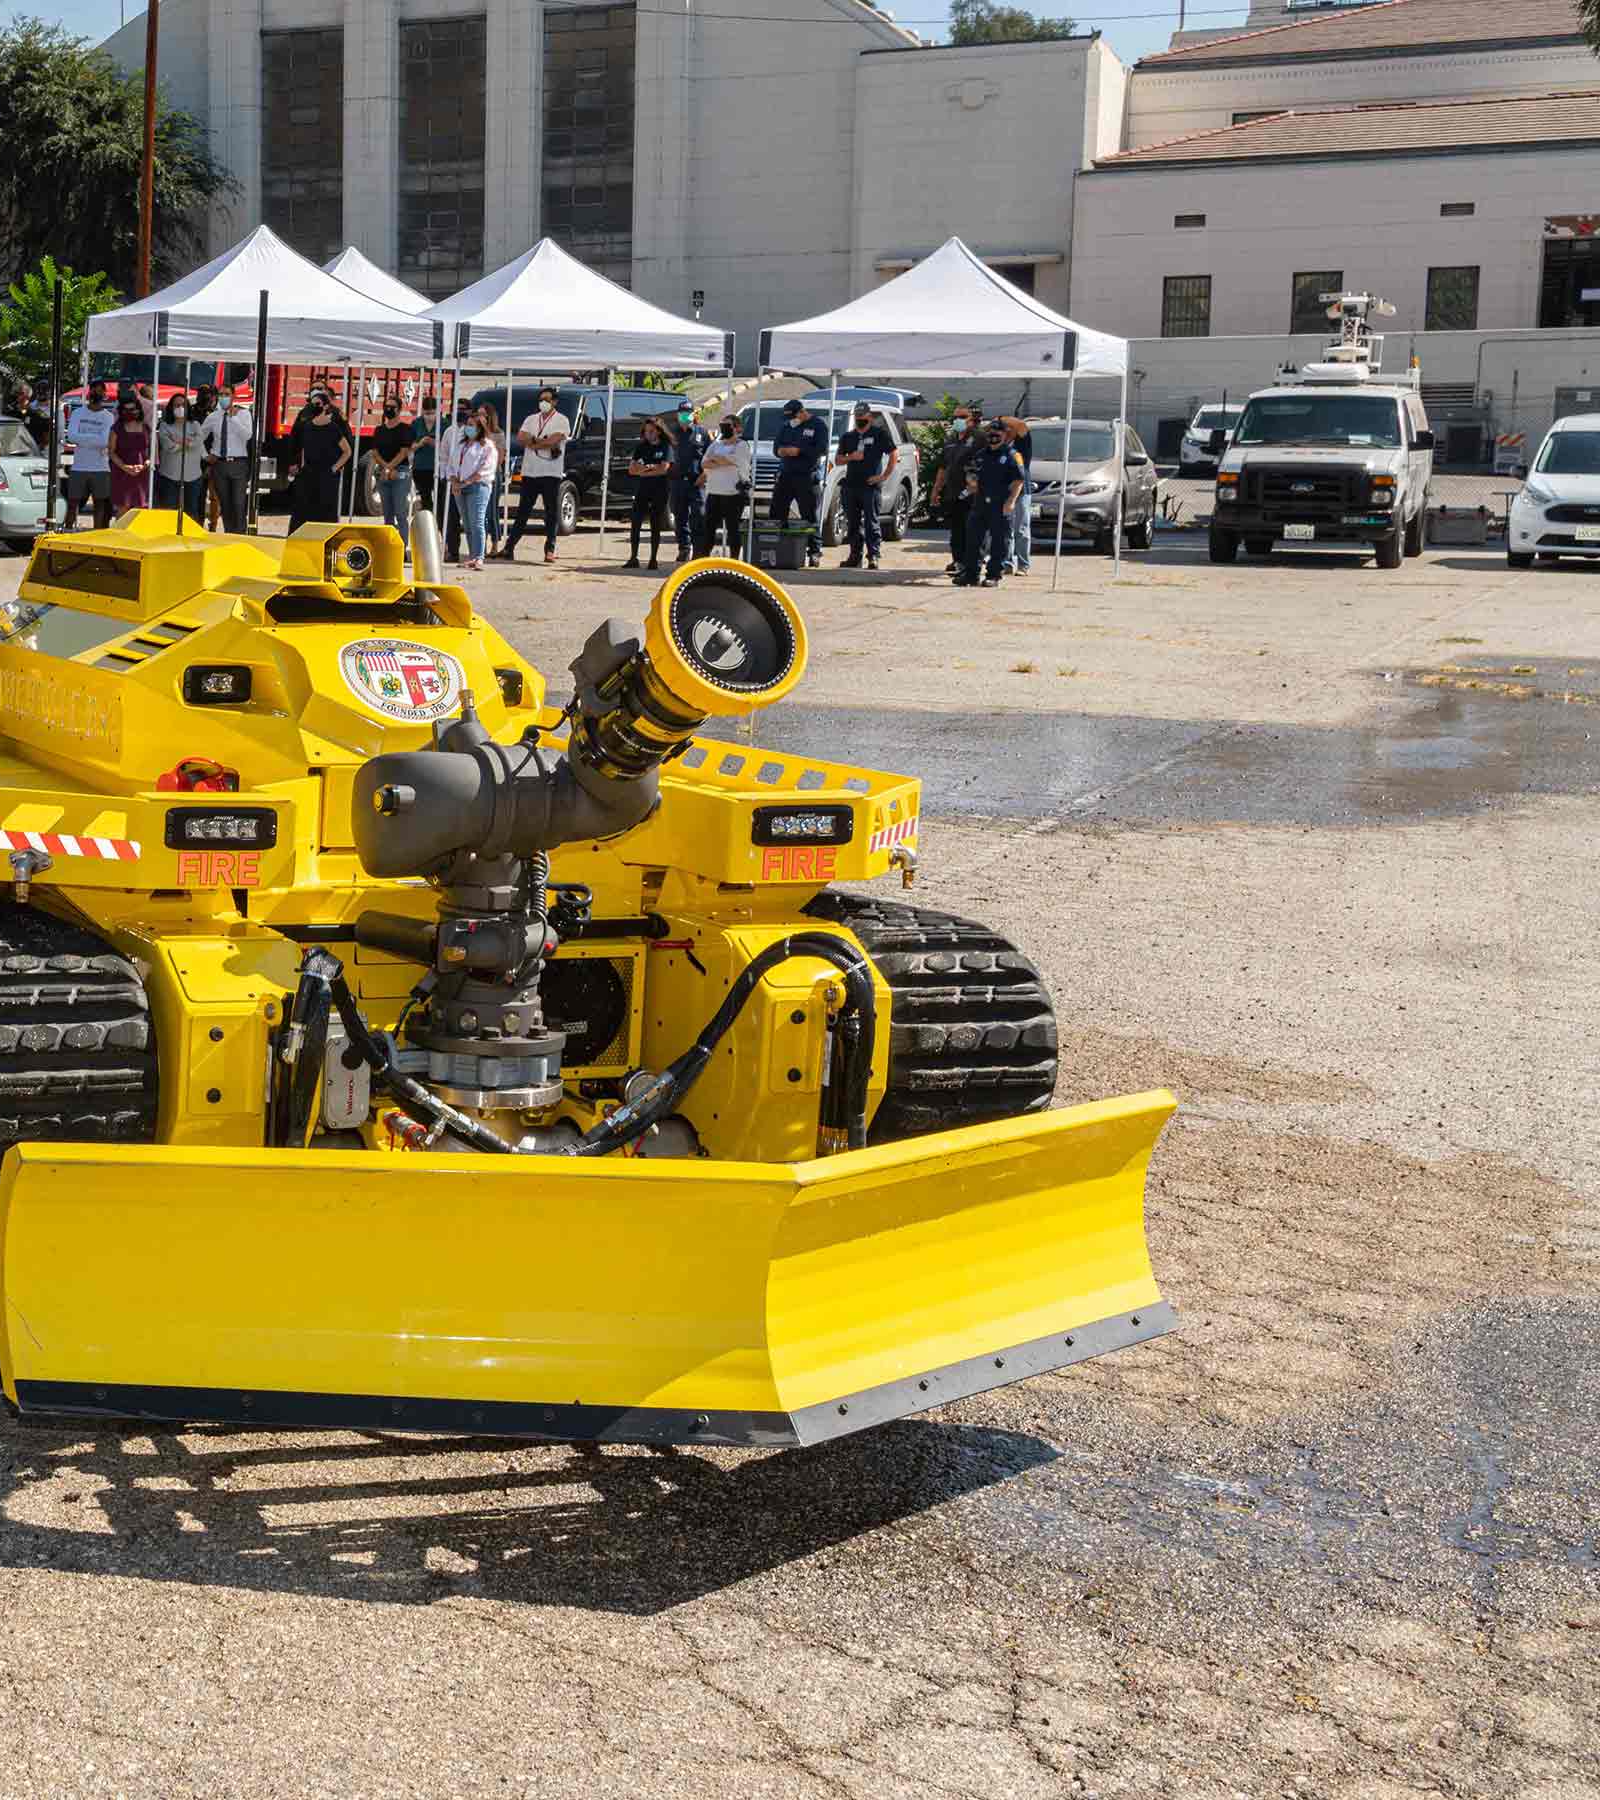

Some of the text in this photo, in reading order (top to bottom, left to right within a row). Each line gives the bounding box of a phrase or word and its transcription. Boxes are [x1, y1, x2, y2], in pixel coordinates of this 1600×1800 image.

[381, 701, 448, 717] FOUNDED 1781
[176, 852, 260, 886] FIRE
[762, 847, 838, 880] FIRE
